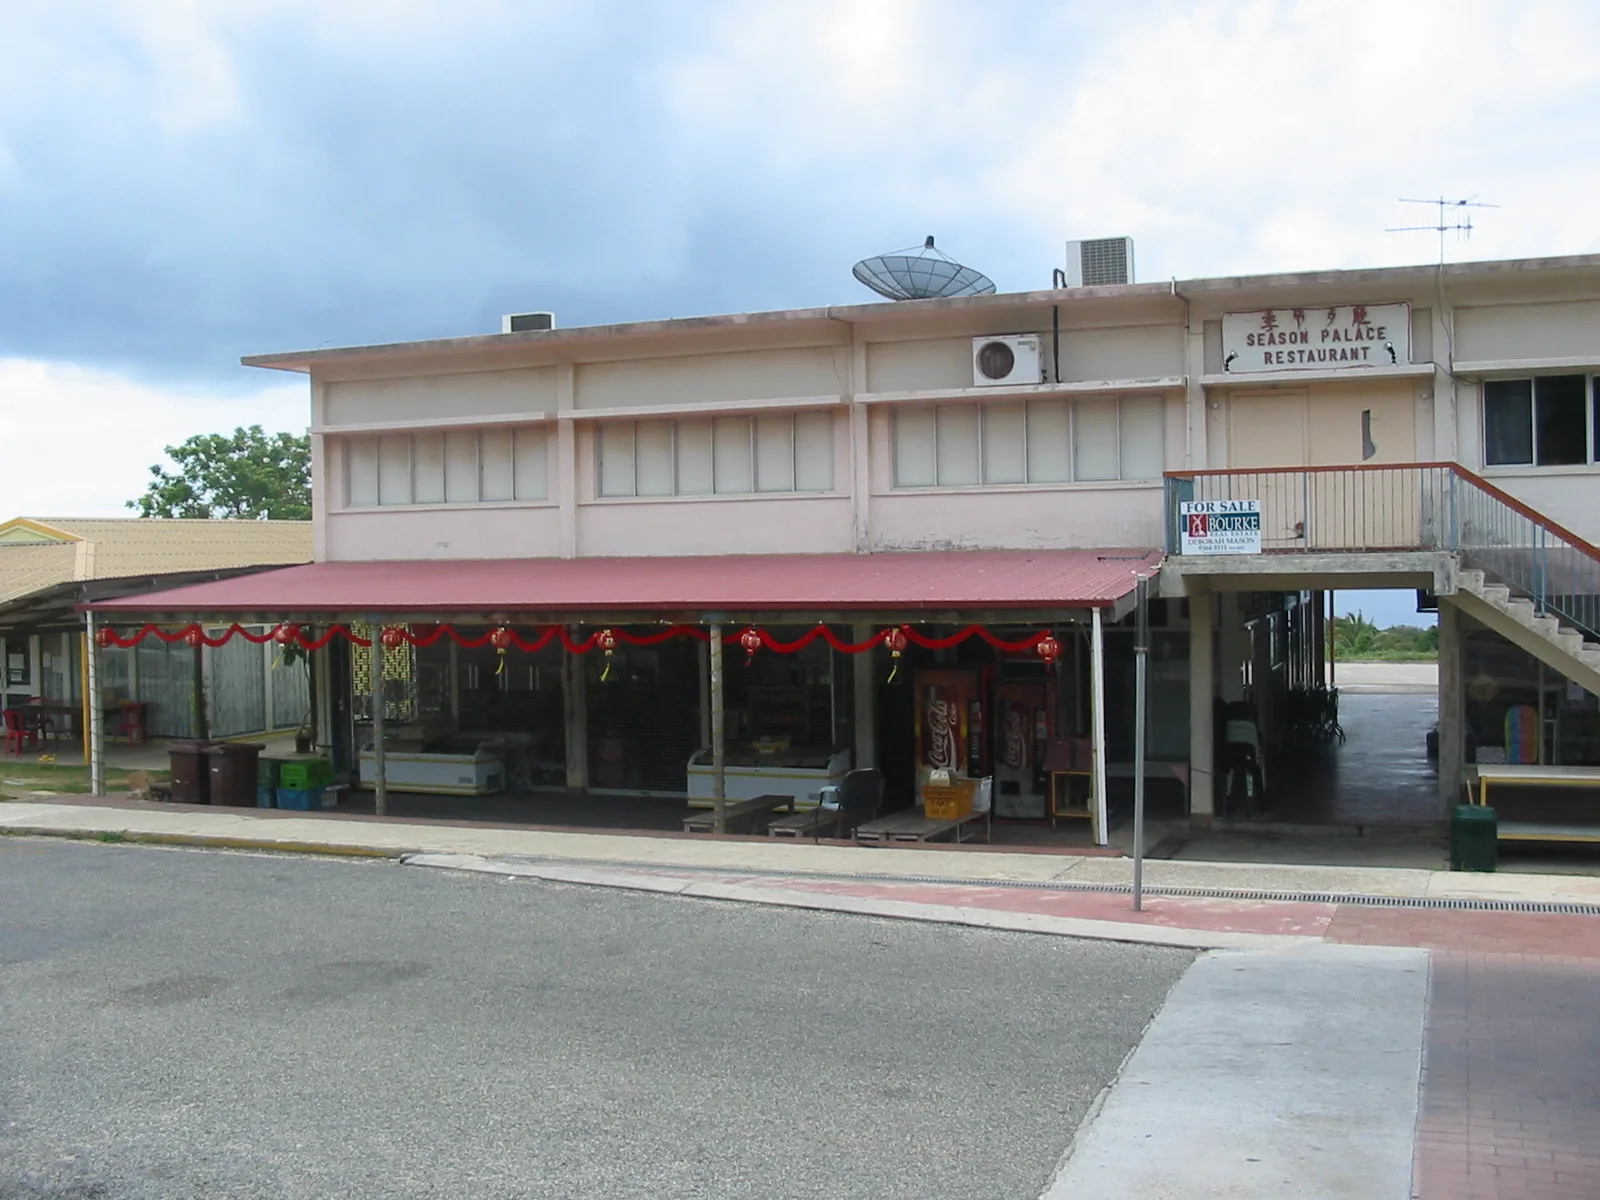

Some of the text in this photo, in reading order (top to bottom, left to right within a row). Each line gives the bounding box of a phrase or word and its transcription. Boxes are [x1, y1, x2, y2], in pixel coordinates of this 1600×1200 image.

[1246, 327, 1386, 347] SEASON PALACE
[1264, 347, 1371, 365] RESTAURANT
[1187, 501, 1256, 512] FOR SALE
[1209, 516, 1258, 531] BOURKE
